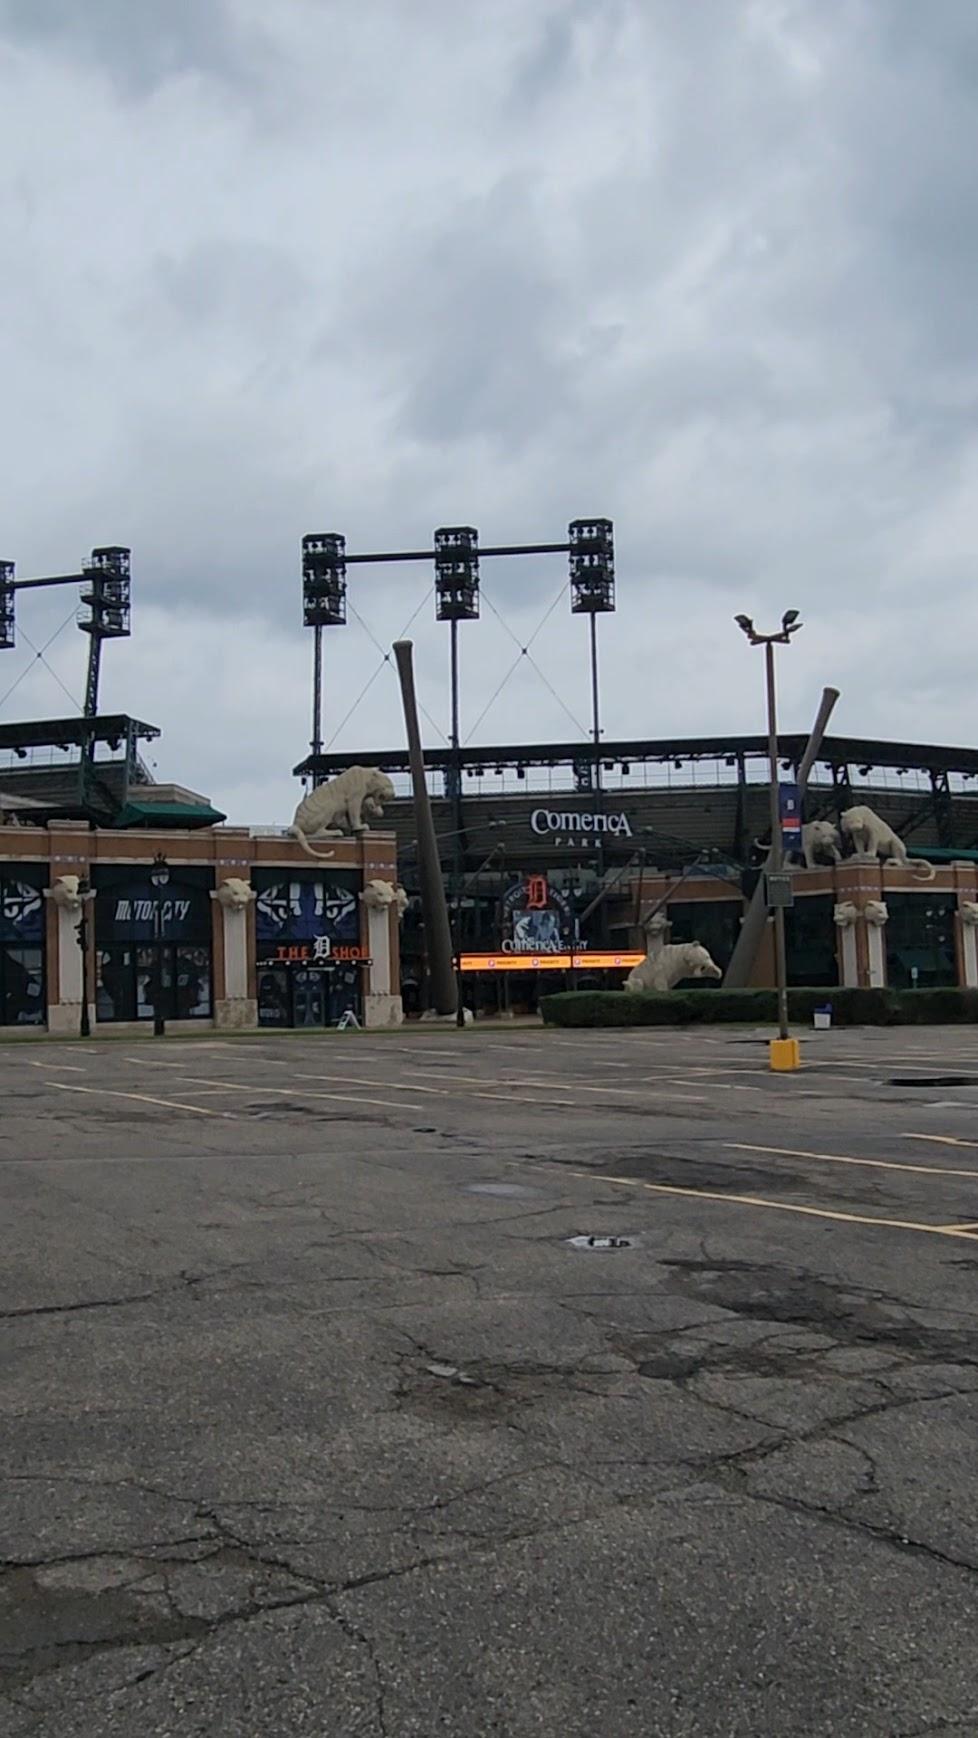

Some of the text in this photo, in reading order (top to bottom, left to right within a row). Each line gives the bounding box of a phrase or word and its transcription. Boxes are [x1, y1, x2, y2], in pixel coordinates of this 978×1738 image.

[554, 837, 602, 848] PARK
[114, 900, 159, 920] MTOR
[277, 945, 309, 960] THE
